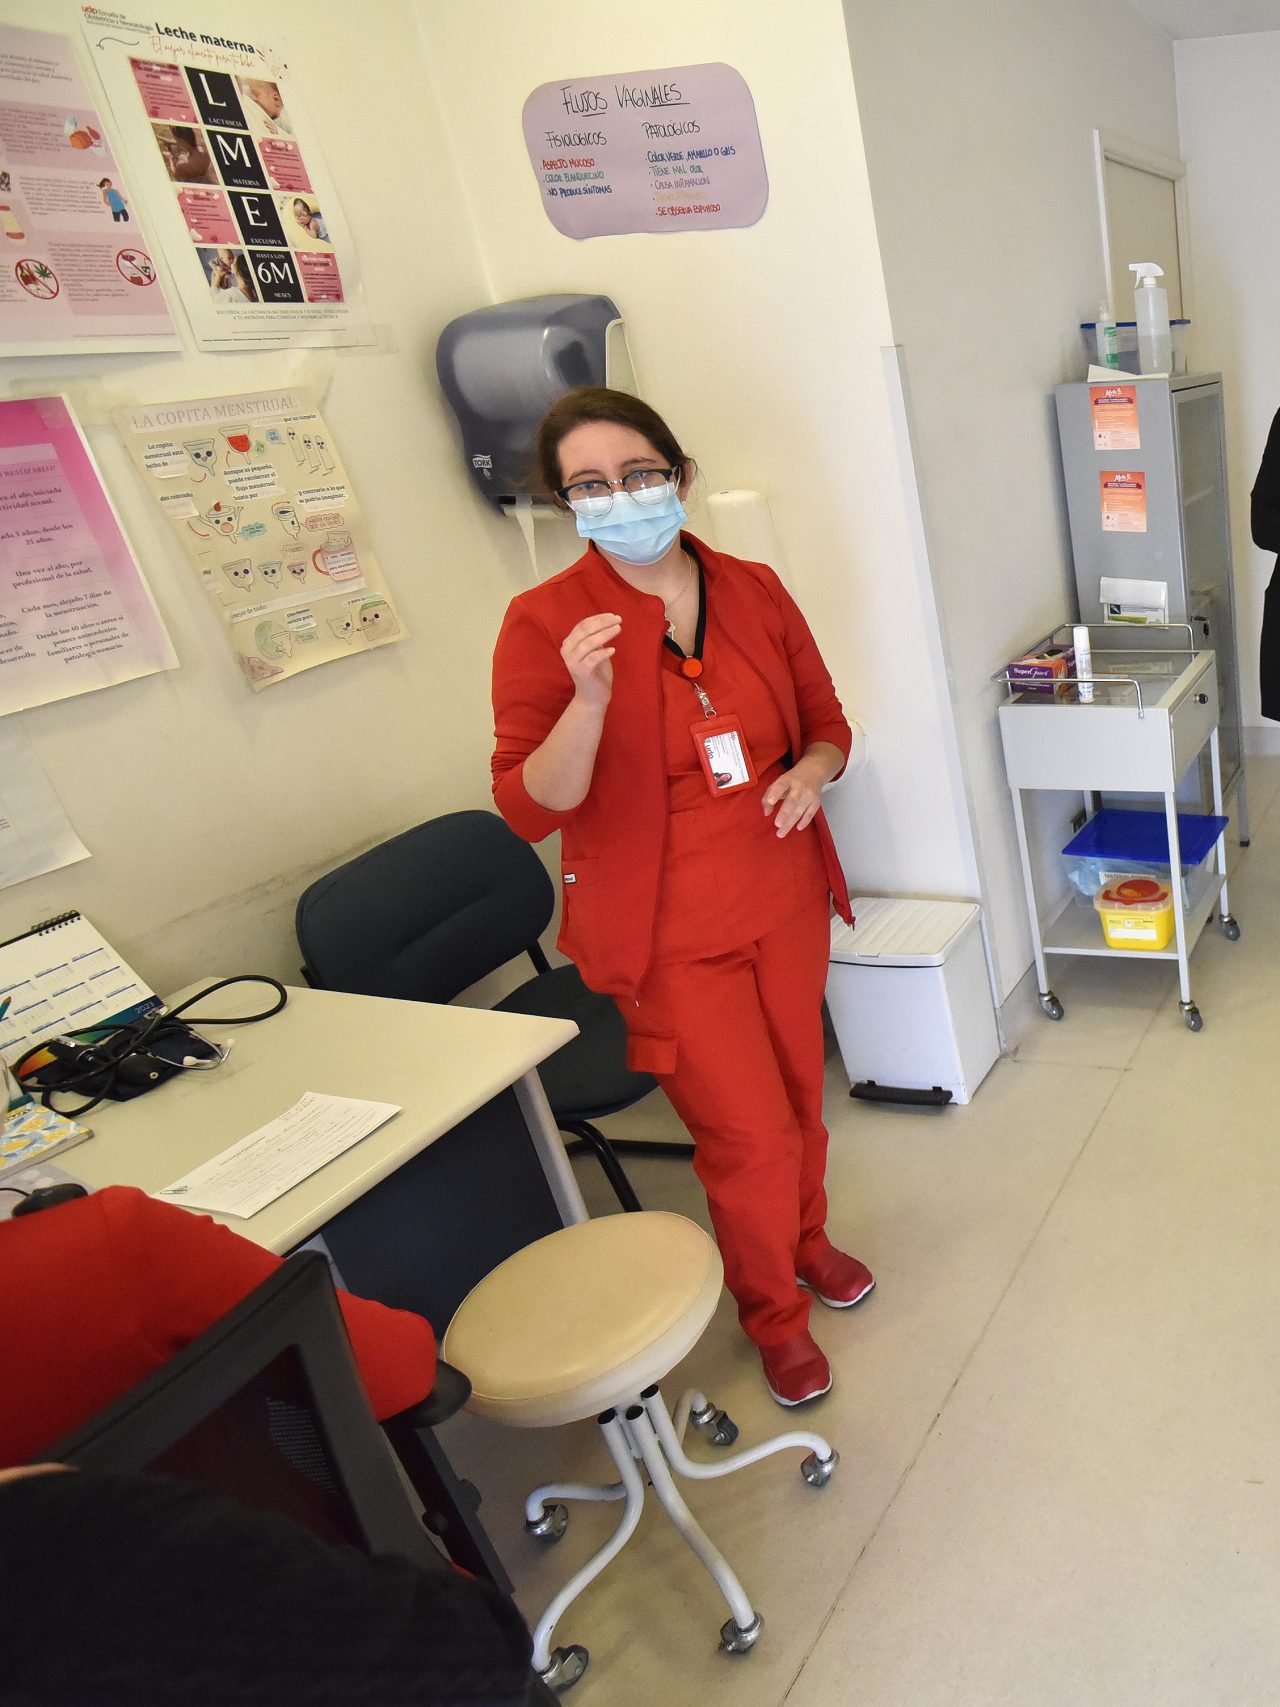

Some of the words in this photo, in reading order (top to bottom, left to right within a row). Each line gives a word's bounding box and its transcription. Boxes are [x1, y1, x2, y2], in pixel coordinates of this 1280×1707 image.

[155, 22, 197, 42] Leche
[200, 33, 255, 54] materna
[199, 73, 226, 107] L
[560, 85, 608, 115] FLUJOS
[615, 83, 682, 109] VAGINALES
[208, 117, 243, 128] LACTANCIA
[216, 134, 252, 168] M
[647, 151, 665, 163] COLOR
[542, 158, 568, 171] ASPECTO
[569, 158, 596, 169] MUCOSO
[649, 165, 670, 176] TIENE
[672, 164, 688, 175] MAL
[232, 178, 260, 187] MATERNA
[544, 174, 563, 183] COLOR
[655, 179, 673, 190] CAUSA
[548, 187, 558, 197] NO
[240, 196, 268, 227] E
[657, 206, 668, 216] SE
[250, 237, 282, 246] EXCLUSIVA
[257, 262, 294, 284] 6M
[132, 412, 155, 430] LA
[156, 407, 212, 426] COPITA
[213, 396, 298, 419] MENSTRUAL
[474, 458, 491, 467] TORK
[20, 605, 41, 614] Cada
[36, 631, 58, 641] Desde
[134, 1001, 155, 1014] 2023
